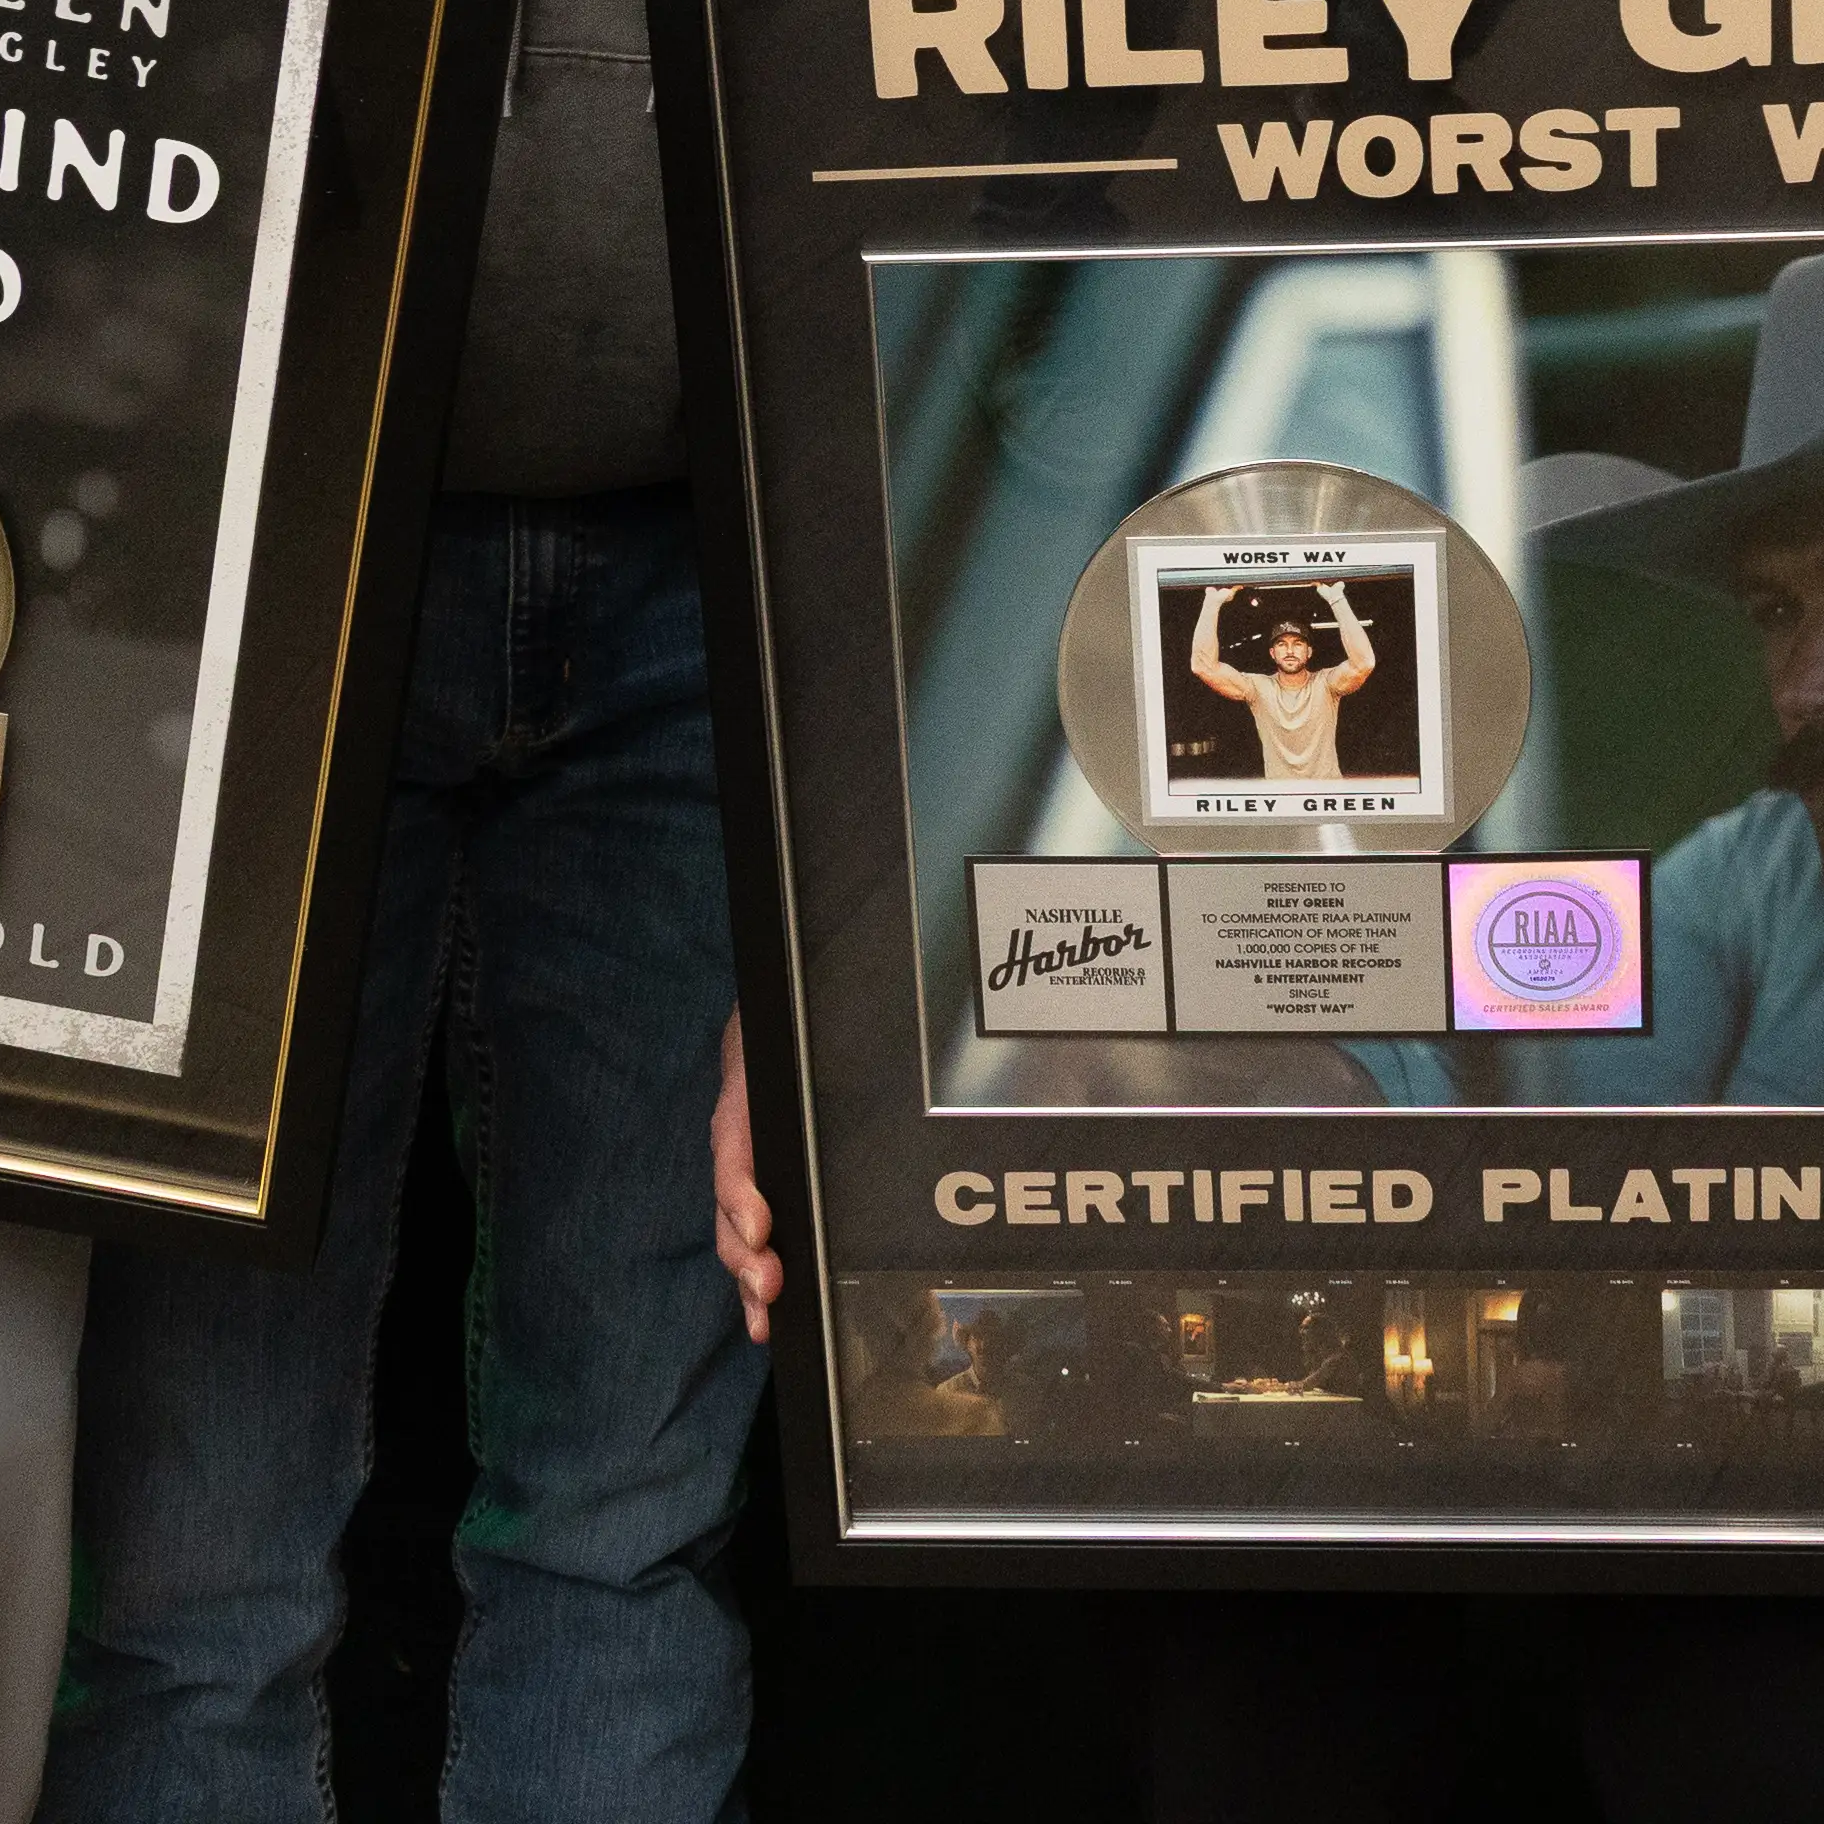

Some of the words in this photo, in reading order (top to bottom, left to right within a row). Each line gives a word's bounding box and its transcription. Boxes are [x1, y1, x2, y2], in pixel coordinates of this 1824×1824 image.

[1216, 106, 1681, 202] WORST
[1223, 551, 1290, 564] WORST
[1303, 551, 1347, 563] WAY
[1196, 799, 1277, 812] RILEY
[1303, 797, 1396, 811] GREEN
[1264, 882, 1327, 893] PRESENTED
[1330, 882, 1346, 892] TO
[1267, 898, 1300, 908] RILEY
[1303, 898, 1345, 908] GREEN
[1025, 909, 1123, 924] NASHVILLE
[1201, 913, 1218, 923] TO
[1220, 913, 1319, 924] COMMEMORATE
[1322, 913, 1350, 923] RIAA
[1353, 912, 1412, 923] PLATINUM
[1514, 910, 1579, 945] RIAA
[1217, 928, 1303, 939] CERTIFICATION
[1306, 928, 1323, 939] OF
[1326, 928, 1362, 938] MORE
[1365, 928, 1397, 938] THAN
[1293, 943, 1337, 954] COPIES
[1339, 943, 1357, 953] OF
[1359, 943, 1380, 953] THE
[988, 923, 1152, 991] Harbor
[1215, 959, 1282, 969] NASHVILLE
[1285, 959, 1338, 969] HARBOR
[1342, 958, 1402, 969] RECORDS
[1082, 967, 1135, 977] RECORDS
[1049, 976, 1146, 986] ENTERTAINMENT
[1254, 974, 1263, 984] &
[1266, 974, 1365, 984] ENTERTAINMENT
[1288, 989, 1330, 999] SINGLE
[1483, 1003, 1536, 1013] CERTIFIED
[1538, 1003, 1570, 1013] SALES
[1573, 1003, 1610, 1012] AWARD
[934, 1168, 1434, 1226] CERTIFIED
